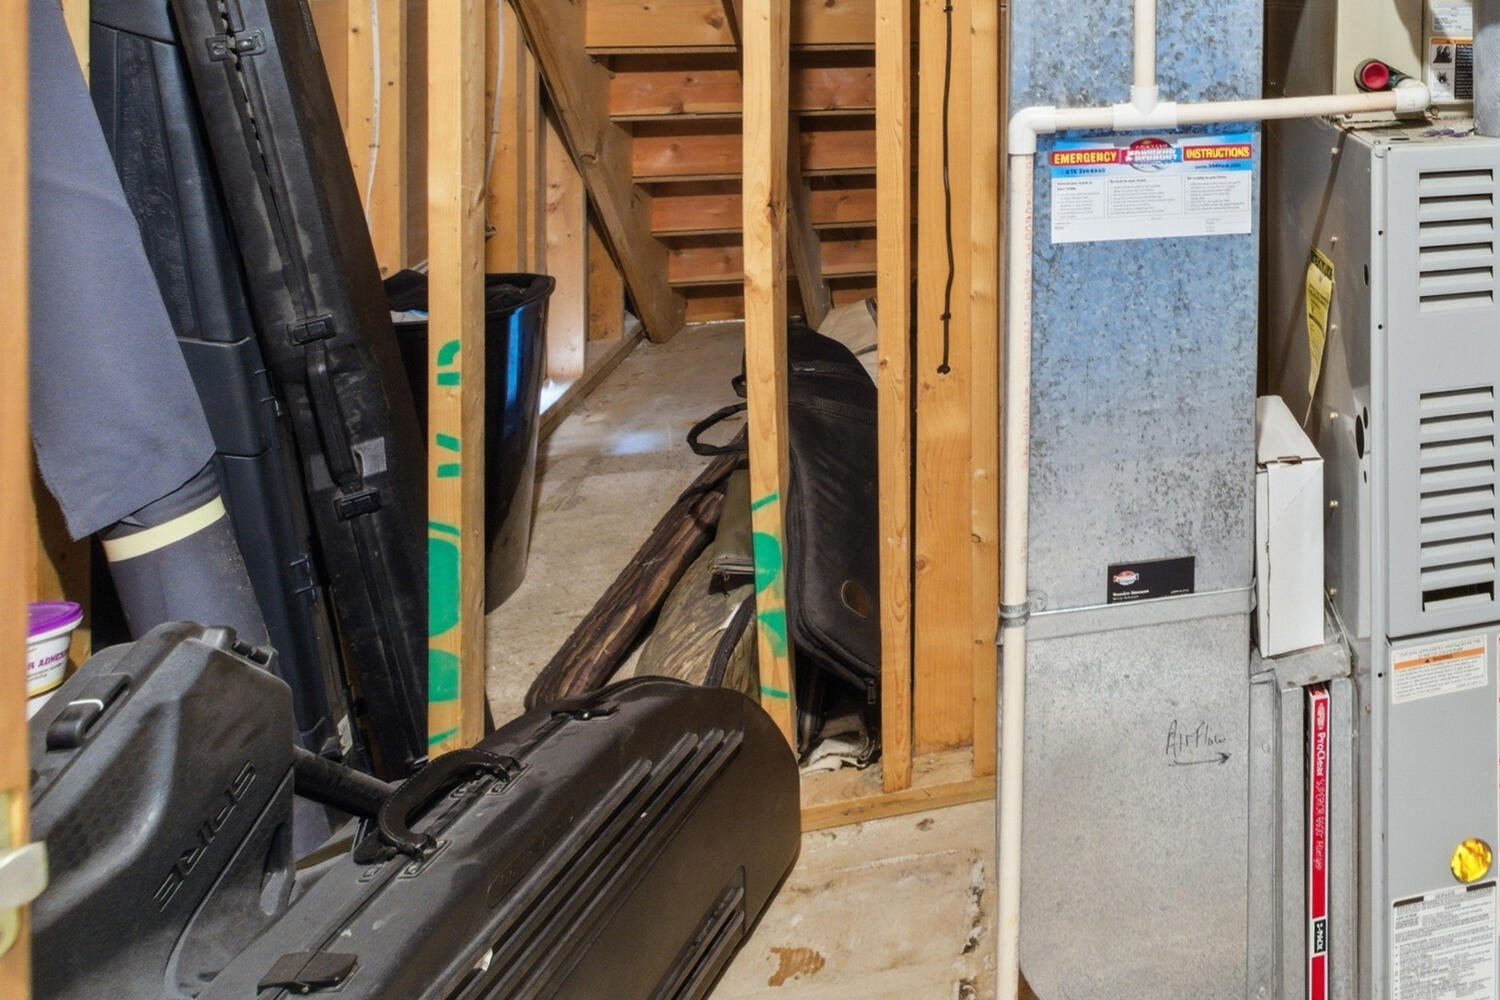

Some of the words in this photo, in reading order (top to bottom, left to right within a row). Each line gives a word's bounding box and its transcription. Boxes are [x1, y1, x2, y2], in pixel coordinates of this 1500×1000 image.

[1054, 151, 1118, 165] EMERGENCY
[1186, 146, 1251, 160] INSTRUCTIONS
[153, 760, 257, 912] SPIRE
